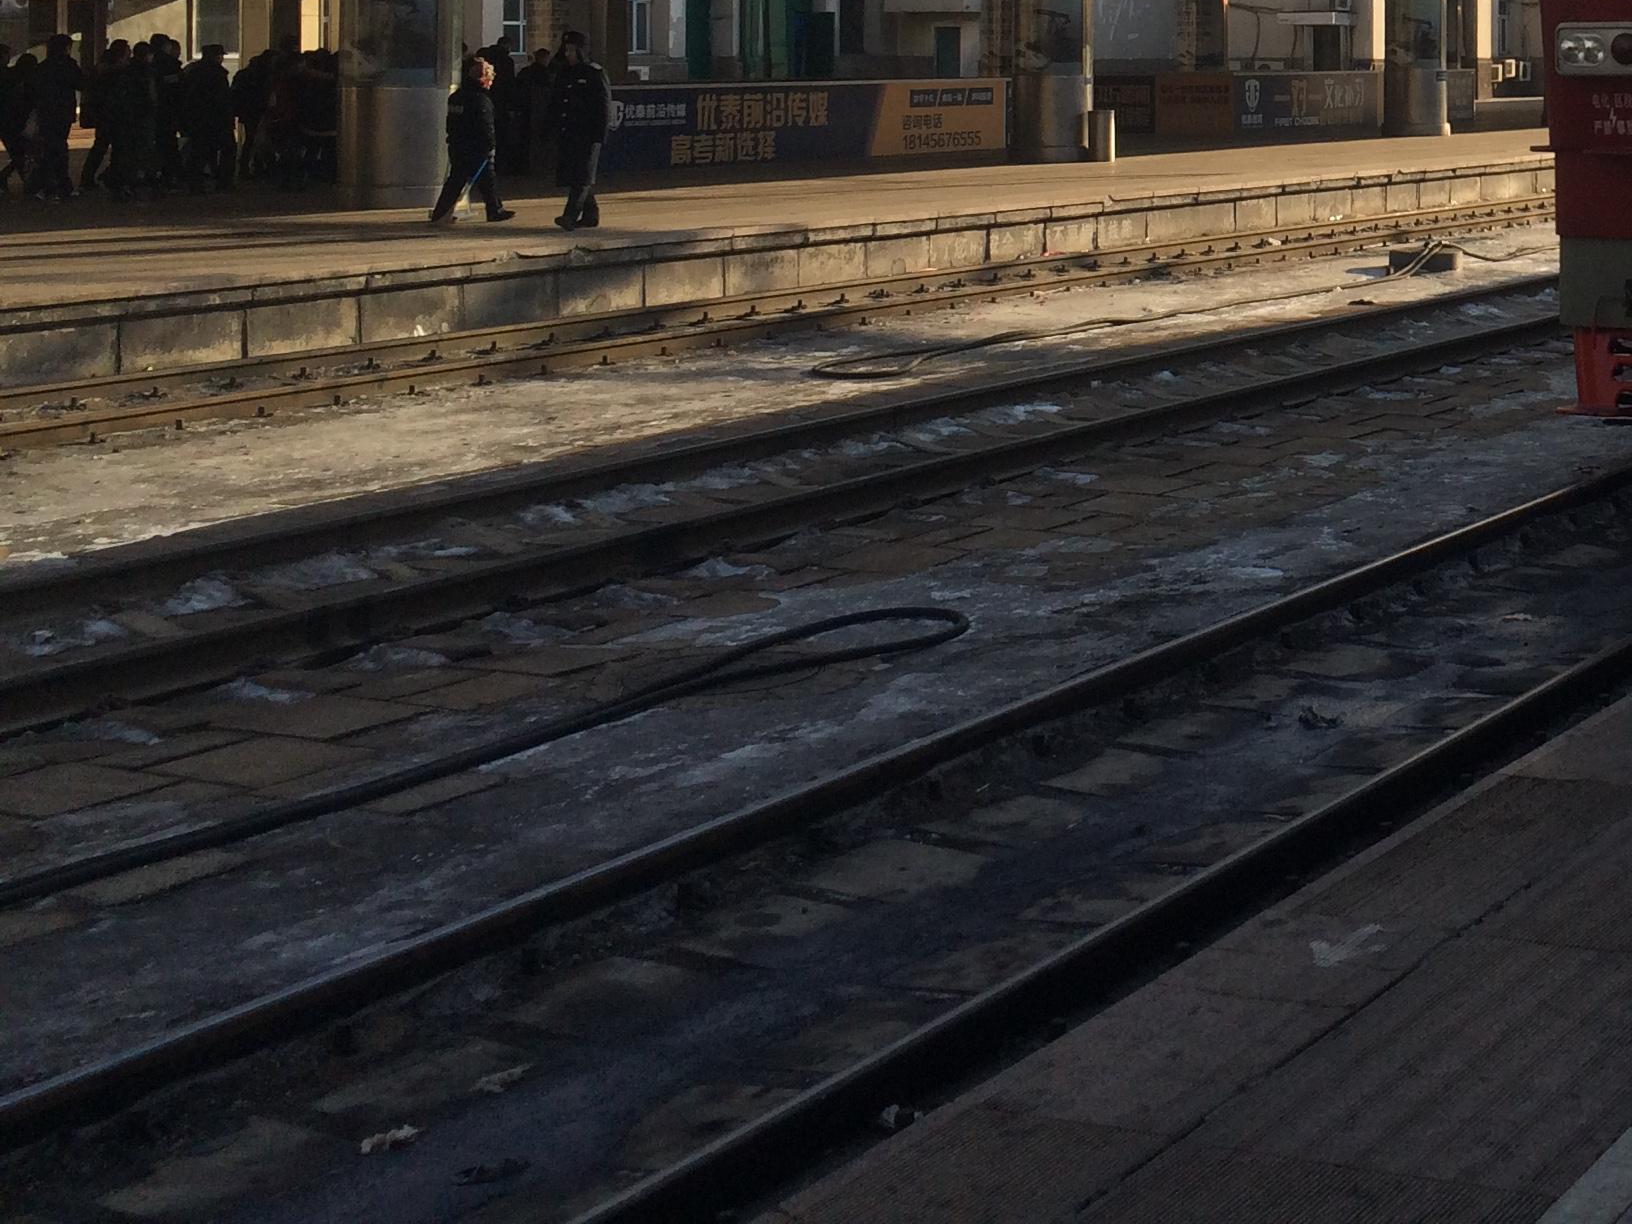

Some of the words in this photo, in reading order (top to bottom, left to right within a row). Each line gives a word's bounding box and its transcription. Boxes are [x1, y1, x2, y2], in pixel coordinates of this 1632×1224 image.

[696, 92, 830, 130] 优泰前沿传媒
[902, 113, 943, 131] 咨询电话
[670, 131, 777, 166] 高考新选择
